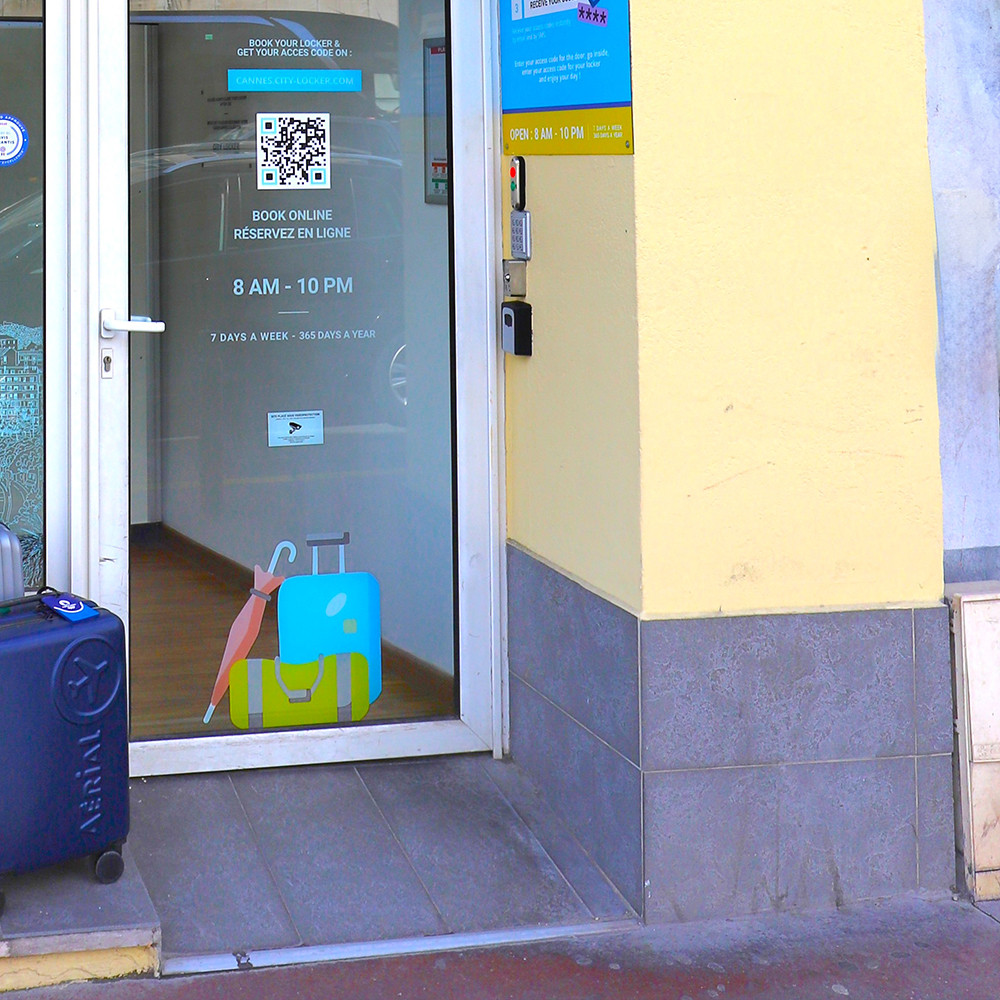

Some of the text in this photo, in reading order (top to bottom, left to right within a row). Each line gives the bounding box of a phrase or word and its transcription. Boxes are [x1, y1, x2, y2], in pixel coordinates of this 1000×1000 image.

[249, 39, 340, 48] BOOK YOUR LOCKER &
[237, 48, 253, 57] GET
[254, 48, 279, 57] YOUR
[280, 48, 309, 57] ACCES
[310, 48, 334, 57] CODE
[335, 48, 348, 57] ON
[236, 76, 354, 86] CANNES.CITY-LOCKER.COM
[510, 128, 529, 141] OPEN
[534, 127, 539, 140] 8
[540, 127, 553, 140] AM
[560, 126, 569, 139] 10
[570, 126, 585, 139] PM
[252, 209, 333, 221] BOOK ONLINE
[234, 226, 351, 240] RÉSERVEZ EN LIGNE
[233, 279, 244, 296] 8
[248, 278, 280, 295] AM
[297, 278, 320, 295] 10
[323, 277, 353, 294] PM
[210, 333, 217, 342] 7
[220, 332, 247, 342] DAYS
[250, 332, 258, 341] A
[260, 332, 289, 341] WEEK
[299, 331, 316, 341] 365
[317, 331, 341, 340] DAYS
[343, 330, 350, 339] A
[352, 330, 376, 339] YEAR
